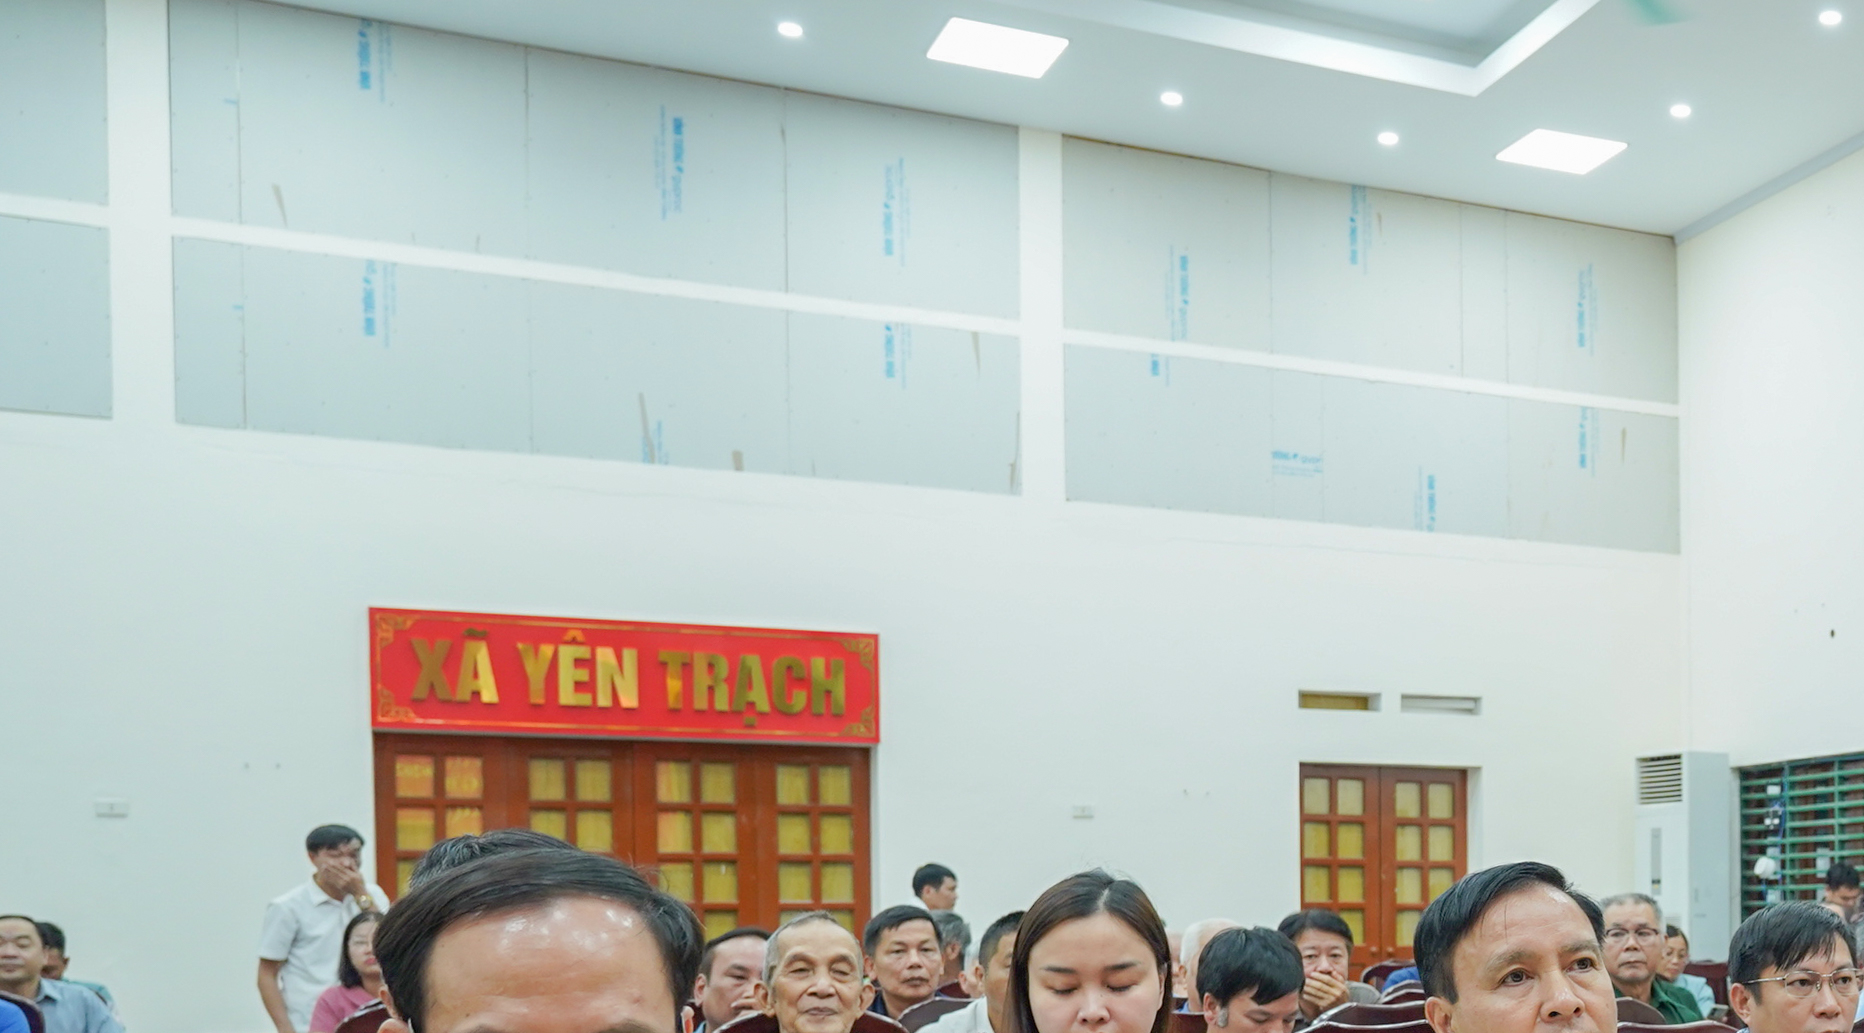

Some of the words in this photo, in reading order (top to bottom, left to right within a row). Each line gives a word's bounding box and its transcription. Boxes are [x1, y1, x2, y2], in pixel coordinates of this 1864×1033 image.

[410, 628, 499, 704] XÃ
[517, 629, 639, 709] YÊN
[657, 652, 847, 728] TRẠCH
